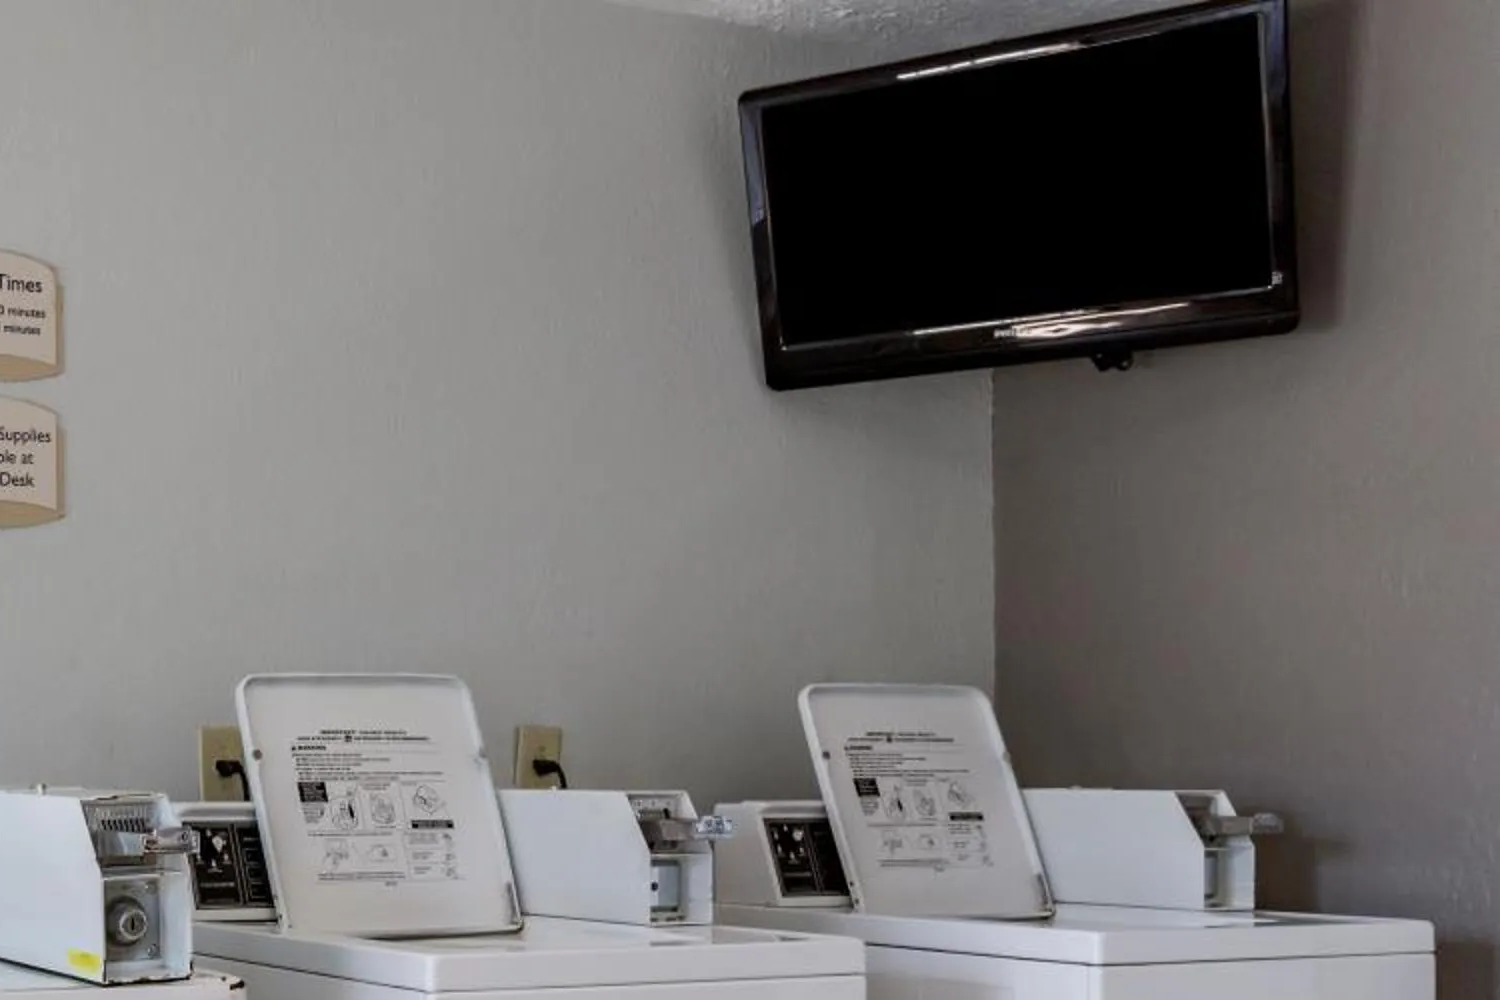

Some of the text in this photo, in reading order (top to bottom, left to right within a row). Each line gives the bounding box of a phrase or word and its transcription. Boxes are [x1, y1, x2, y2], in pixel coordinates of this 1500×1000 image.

[7, 306, 46, 319] minutes
[3, 324, 41, 335] minutes
[22, 453, 34, 465] at
[0, 472, 35, 488] Desk
